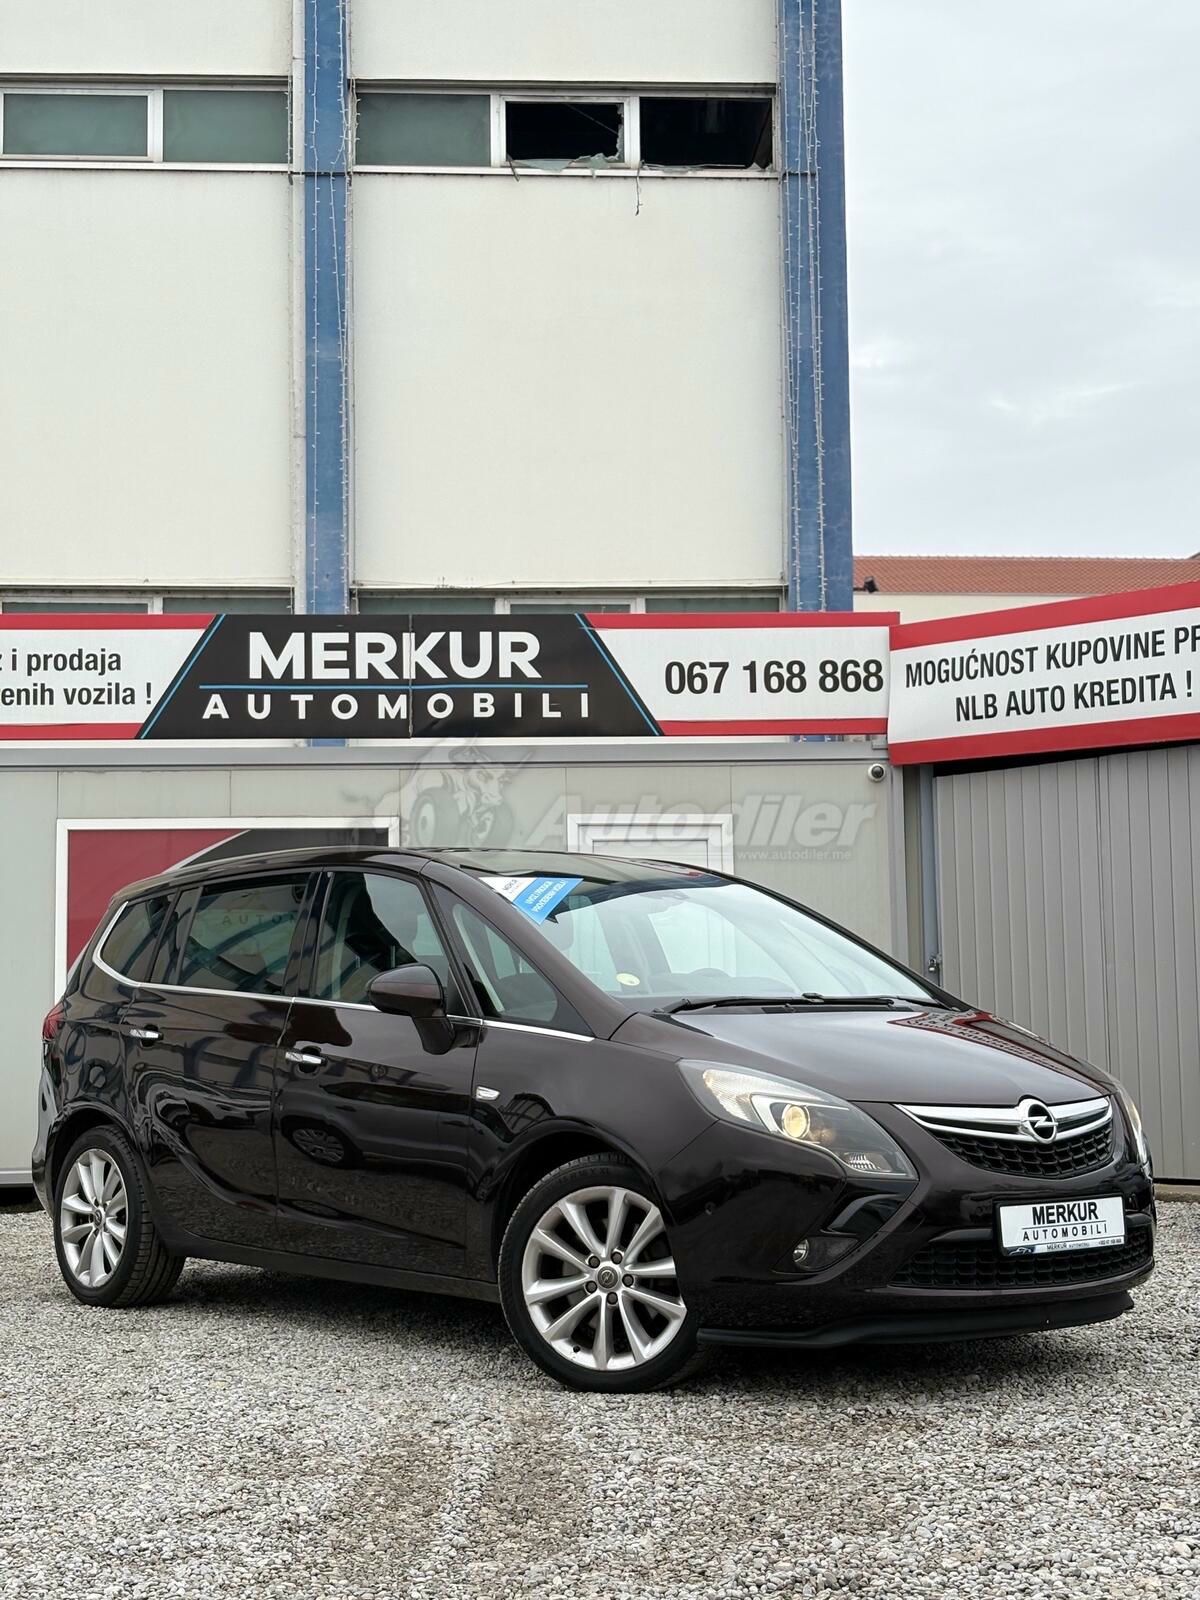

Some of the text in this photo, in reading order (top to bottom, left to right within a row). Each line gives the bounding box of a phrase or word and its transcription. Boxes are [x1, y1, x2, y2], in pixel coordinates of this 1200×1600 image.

[11, 647, 18, 671] i
[26, 647, 122, 677] prodaja
[248, 631, 542, 680] MERKUR
[905, 646, 1039, 688] MOGUĆNOST
[1045, 629, 1166, 671] KUPOVINE
[664, 658, 885, 695] 067 168 868
[63, 682, 136, 705] vozila
[201, 692, 589, 720] AUTOMOBILI
[955, 692, 998, 722] NLB
[1005, 684, 1066, 718] AUTO
[1073, 672, 1178, 710] KREDITA
[1031, 1201, 1099, 1226] MERKUR
[1022, 1223, 1108, 1242] AUTOMOBILI
